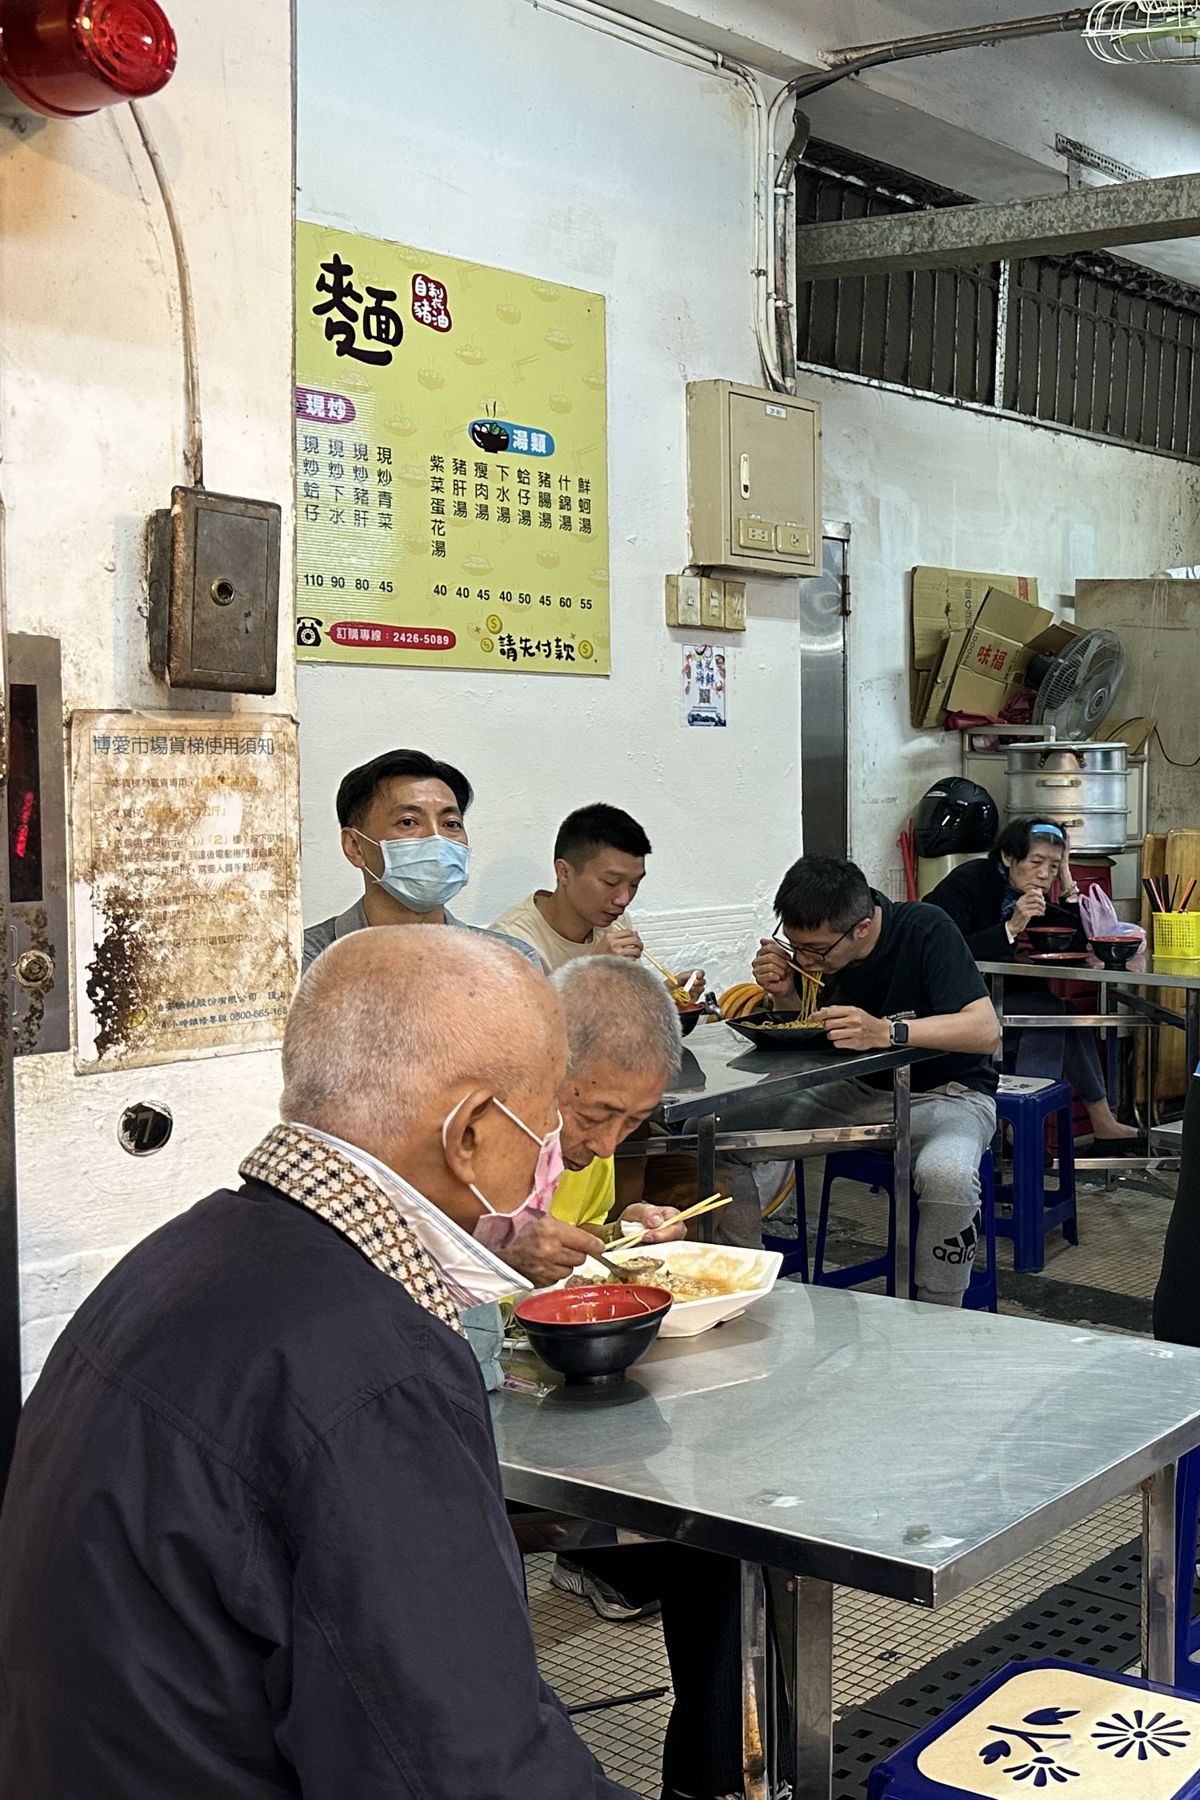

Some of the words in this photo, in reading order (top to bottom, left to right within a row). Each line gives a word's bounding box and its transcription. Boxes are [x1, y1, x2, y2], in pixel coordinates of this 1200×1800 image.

[312, 253, 403, 366] 麵
[414, 275, 444, 310] 自製
[414, 299, 449, 329] 豬油
[303, 393, 346, 420] 現炒
[328, 439, 345, 524] 現炒下水
[353, 443, 369, 528] 現炒豬肝
[376, 446, 393, 530] 現炒青菜
[430, 455, 446, 558] 紫菜蛋花湯
[452, 458, 468, 518] 豬肝湯
[474, 461, 490, 521] 瘦肉湯
[496, 464, 511, 524] 下水湯
[517, 467, 532, 527] 蛤仔湯
[538, 471, 552, 529] 豬腸湯
[558, 474, 573, 532] 什錦湯
[578, 477, 592, 534] 鮮蚵湯
[304, 574, 324, 587] 110
[331, 576, 345, 588] 90
[355, 578, 369, 590] 80
[379, 581, 393, 593] 45
[433, 584, 447, 596] 40
[456, 587, 470, 598] 40
[477, 589, 490, 601] 45
[499, 591, 512, 602] 40
[518, 593, 531, 605] 50
[539, 595, 552, 607] 45
[559, 597, 572, 608] 60
[580, 599, 592, 610] 55
[393, 631, 449, 645] 2426-5089
[498, 633, 576, 662] 請先付款
[93, 735, 275, 756] 博愛市場貨梯使用須知
